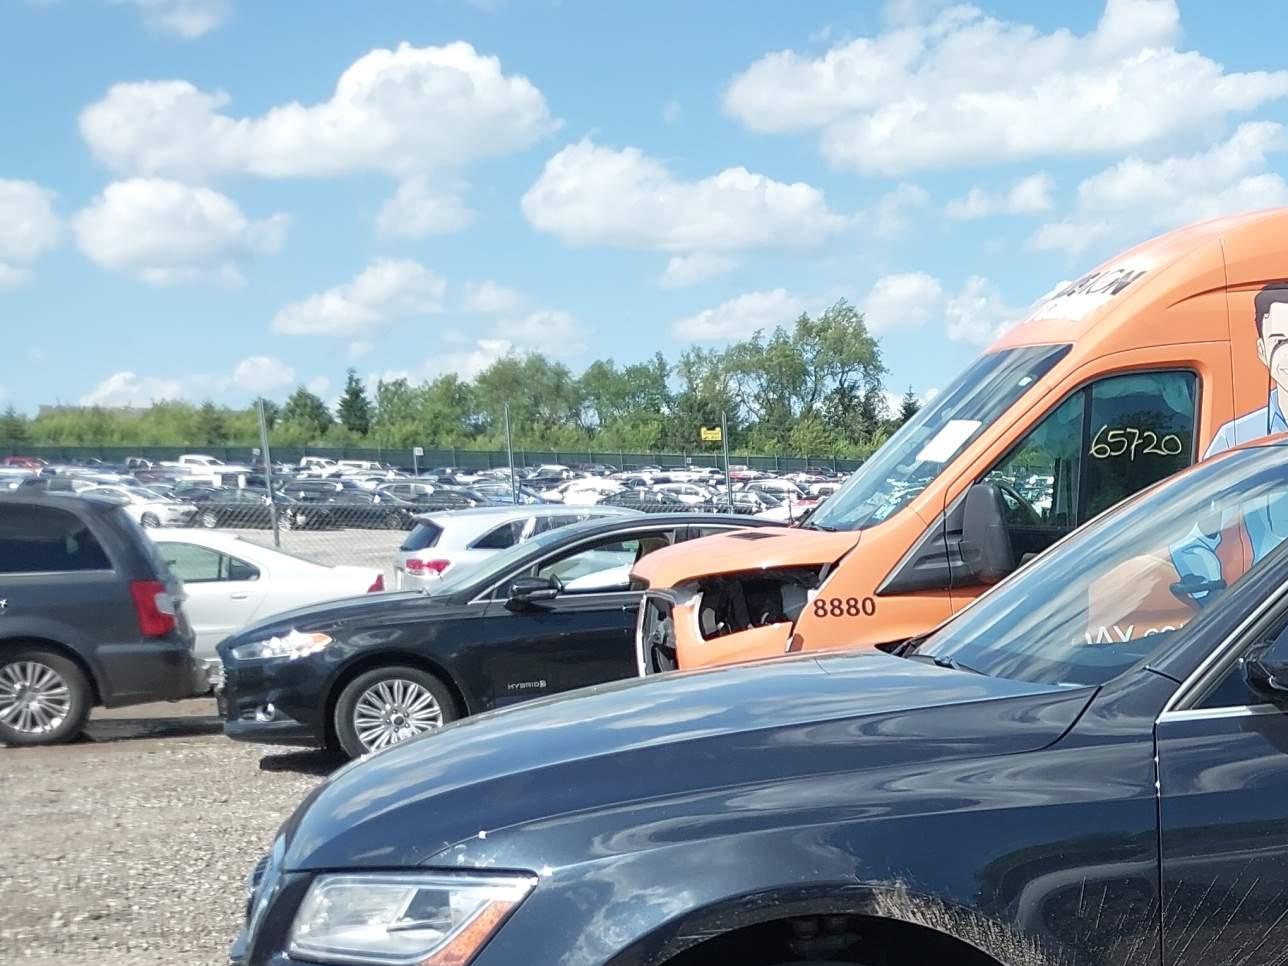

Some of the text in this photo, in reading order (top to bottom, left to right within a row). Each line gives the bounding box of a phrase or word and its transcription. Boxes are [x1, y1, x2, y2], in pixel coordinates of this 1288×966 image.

[1088, 424, 1182, 461] 65720
[813, 596, 876, 618] 8880
[507, 681, 540, 690] HYBRID
